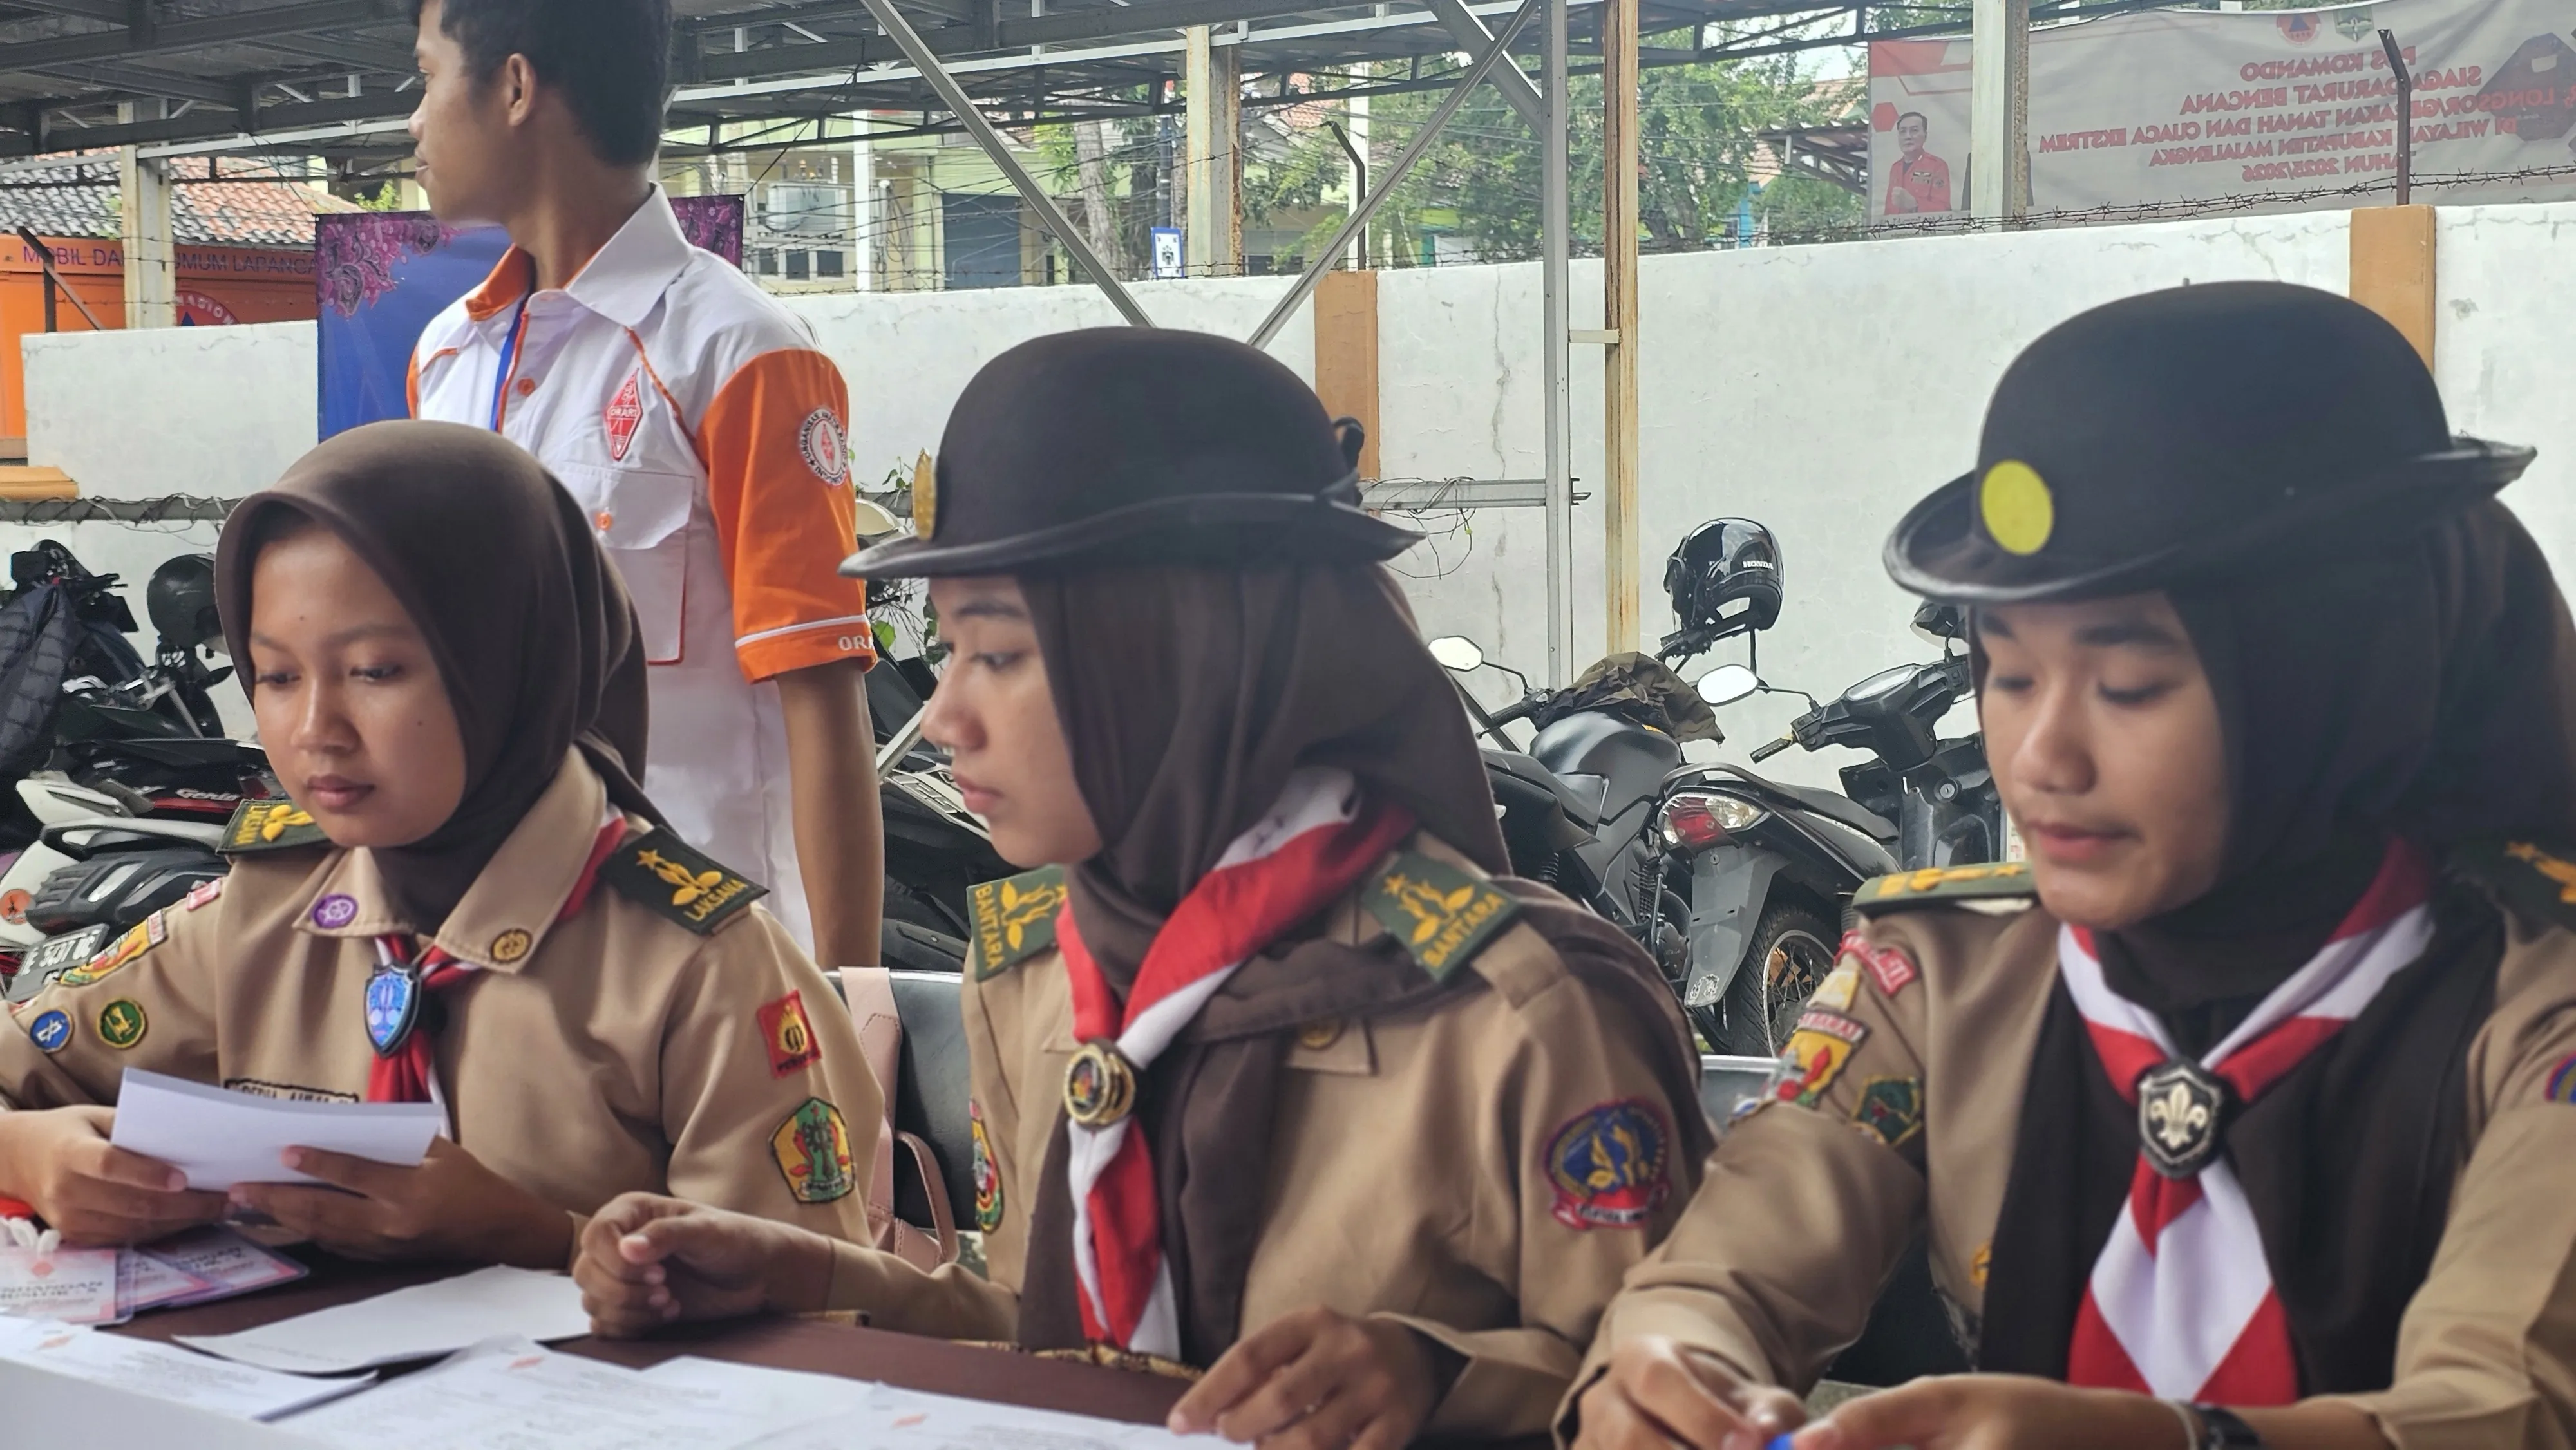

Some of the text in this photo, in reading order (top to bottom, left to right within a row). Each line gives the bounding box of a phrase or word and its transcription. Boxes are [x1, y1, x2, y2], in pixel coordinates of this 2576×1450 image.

[1743, 560, 1774, 570] HONDA
[176, 788, 242, 801] Genio
[974, 884, 1005, 970] BANTARA
[1423, 892, 1507, 968] BANTARA
